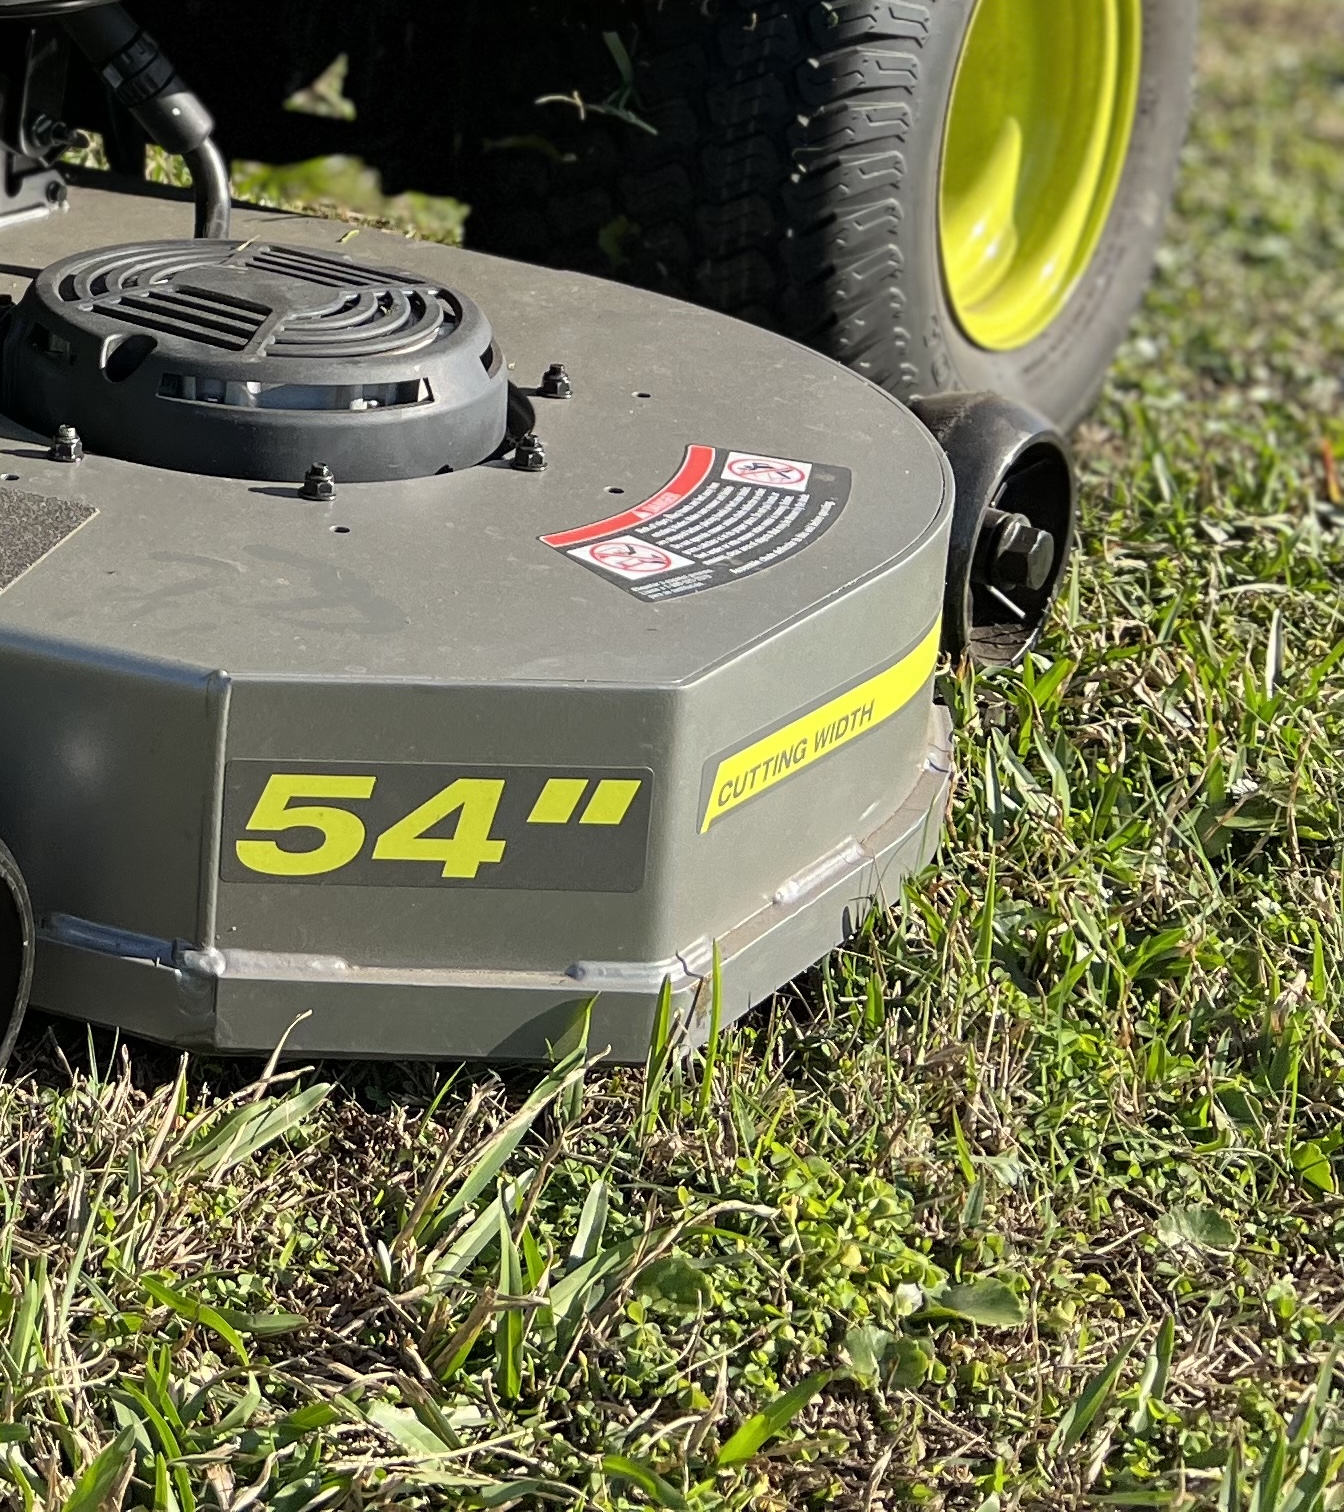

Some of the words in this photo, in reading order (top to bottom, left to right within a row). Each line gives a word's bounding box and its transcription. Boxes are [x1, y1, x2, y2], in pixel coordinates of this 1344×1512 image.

[717, 737, 808, 807] CUTTING
[813, 698, 876, 754] WIDTH
[233, 774, 642, 880] 54"
